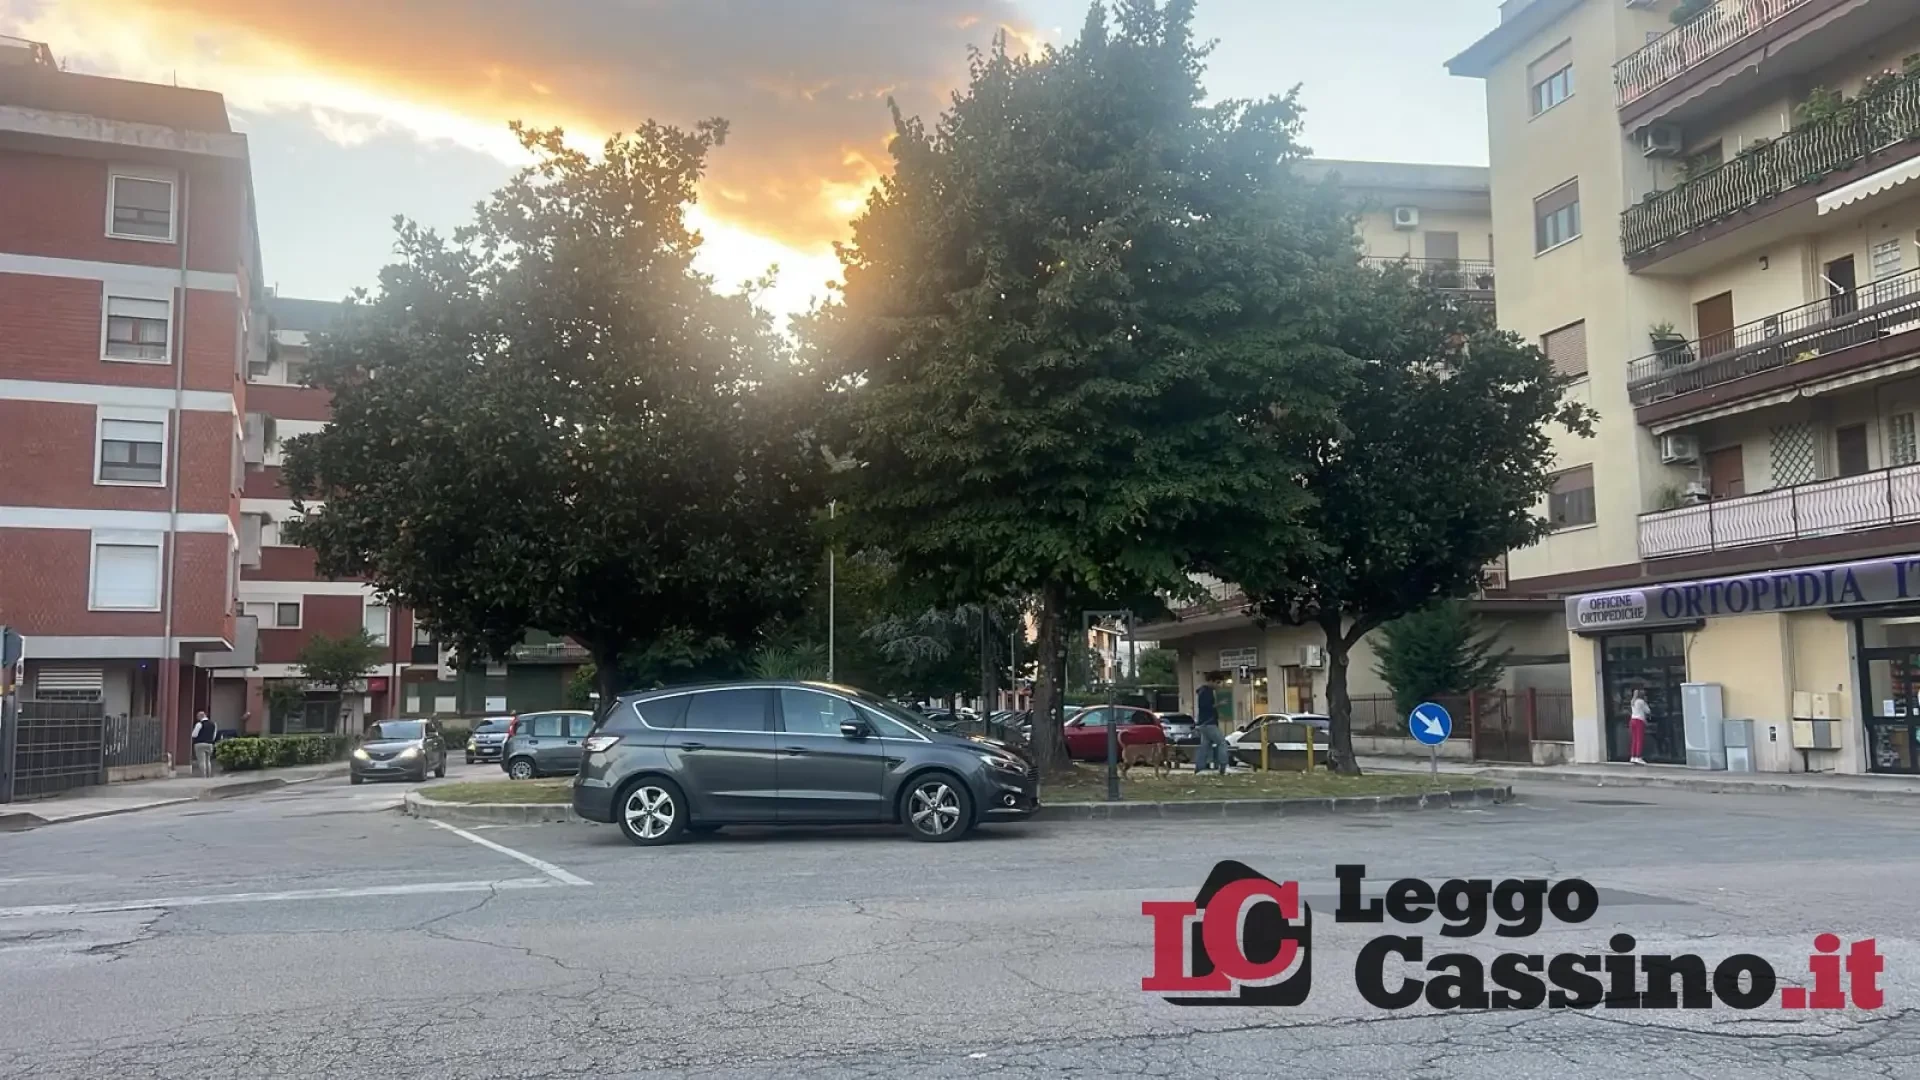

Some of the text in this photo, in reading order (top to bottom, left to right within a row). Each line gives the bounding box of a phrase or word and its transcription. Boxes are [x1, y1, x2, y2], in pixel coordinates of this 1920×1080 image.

[1661, 568, 1865, 618] ORTOPEDIA
[1589, 594, 1633, 611] OFFICINE
[1580, 606, 1645, 624] ORTOPEDICHE
